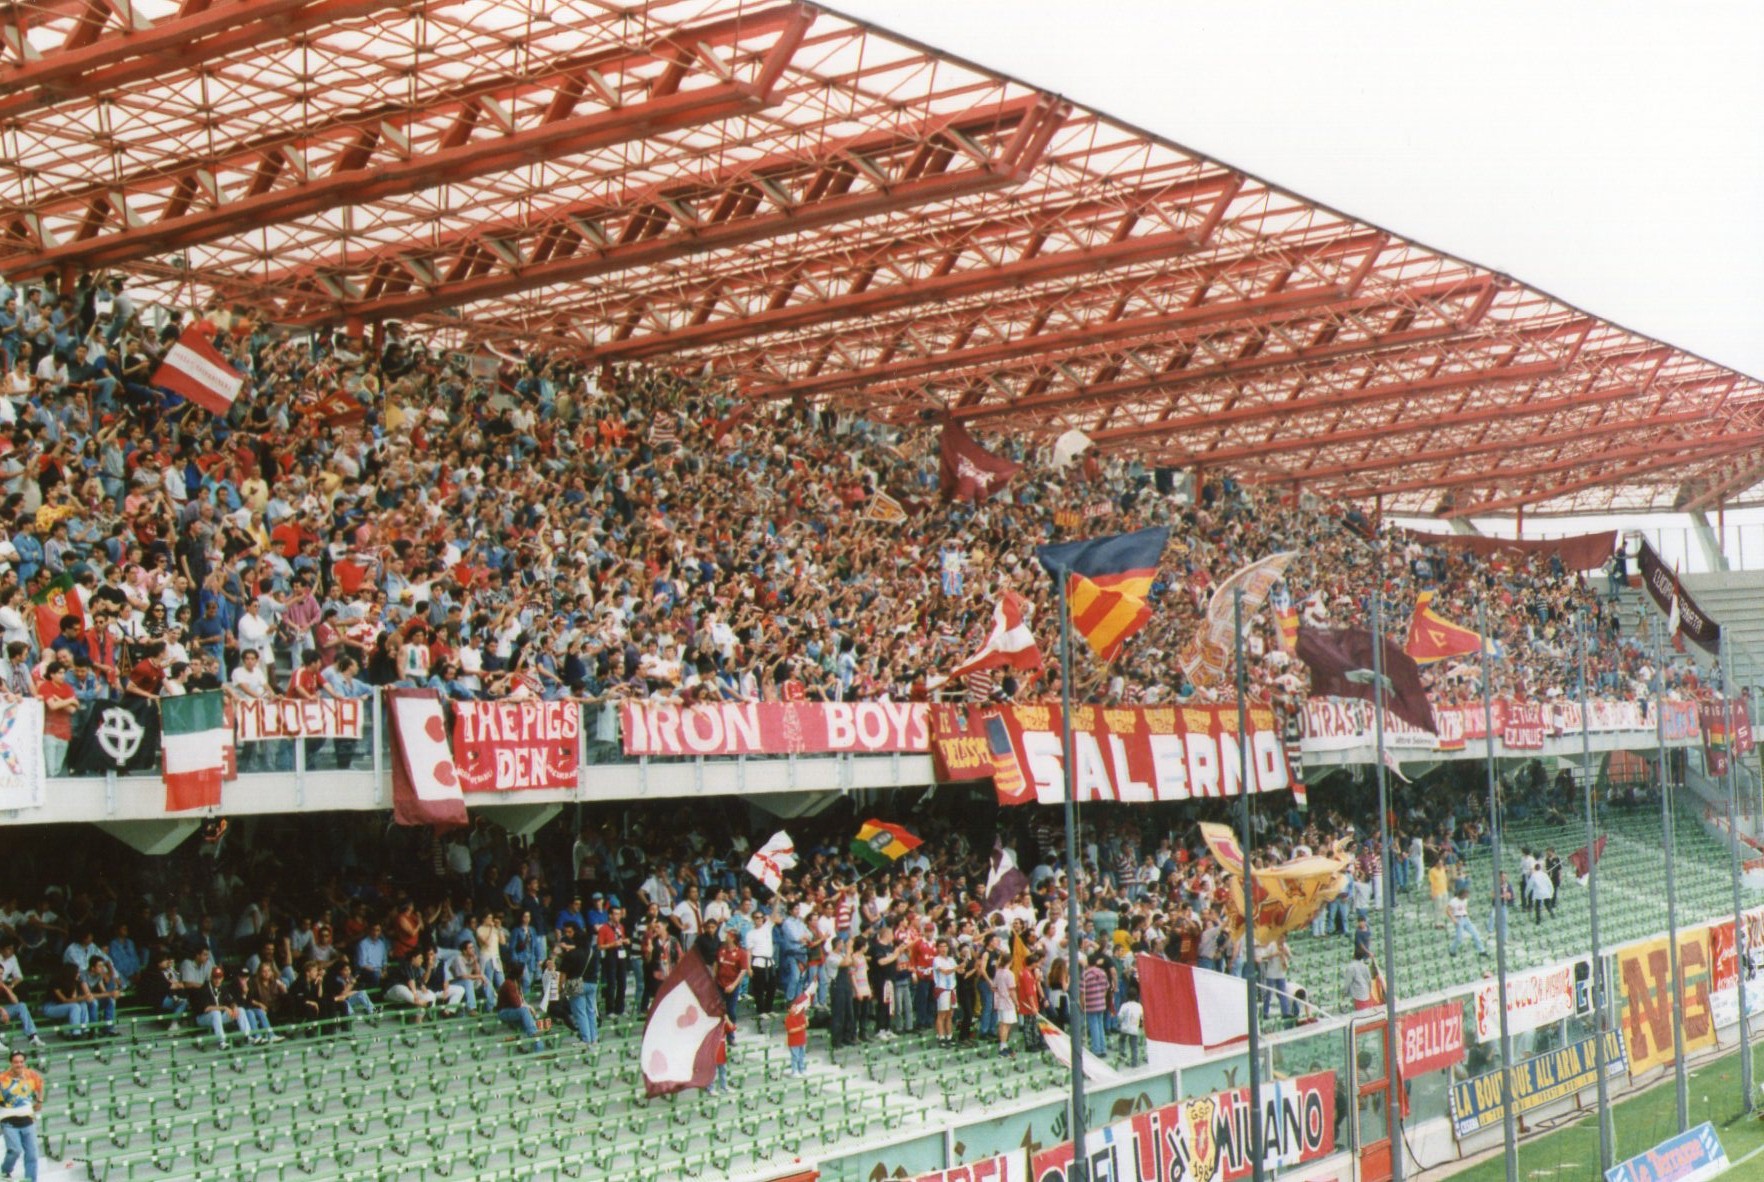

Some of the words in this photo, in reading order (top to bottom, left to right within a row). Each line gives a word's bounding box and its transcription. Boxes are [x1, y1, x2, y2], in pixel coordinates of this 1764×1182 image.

[240, 699, 358, 738] MODENA
[629, 700, 763, 752] IRON
[823, 700, 930, 750] BOYS
[495, 747, 548, 789] DEN
[1022, 731, 1288, 804] SALERNO
[1405, 1014, 1462, 1065] BELLIZZI
[1454, 1085, 1473, 1119] LA
[1474, 1063, 1533, 1112] BOUTQUE
[1535, 1045, 1582, 1090] ALL'ARIA
